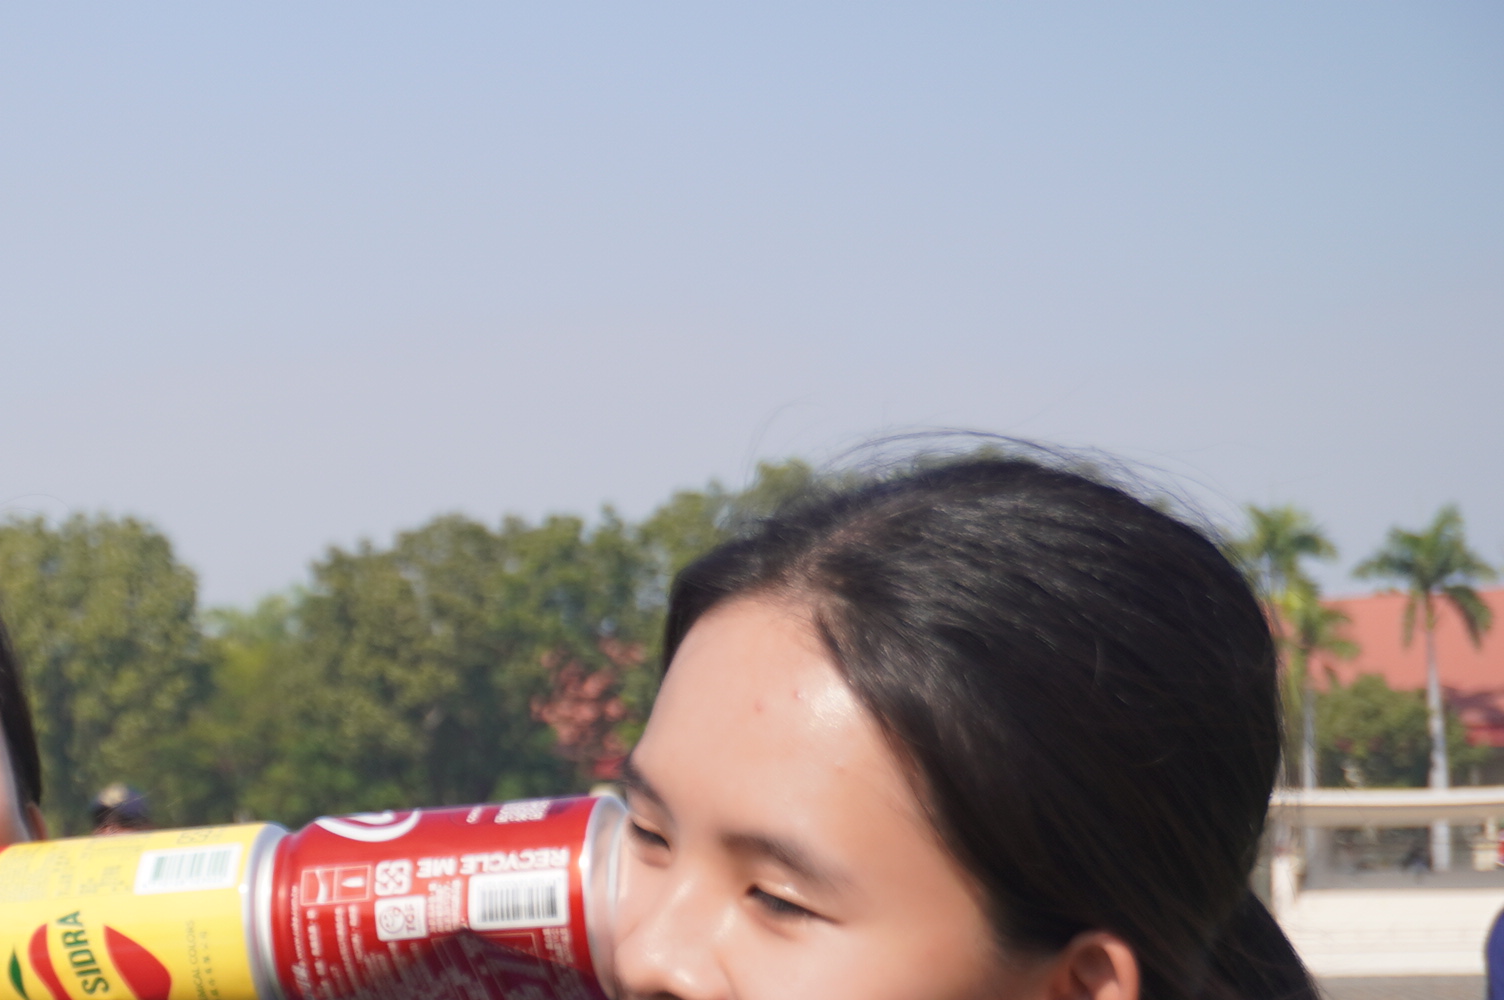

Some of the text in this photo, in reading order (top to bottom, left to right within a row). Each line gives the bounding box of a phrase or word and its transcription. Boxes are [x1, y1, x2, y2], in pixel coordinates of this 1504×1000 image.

[415, 847, 570, 879] RECYCLE ME
[56, 911, 110, 995] SIDRA
